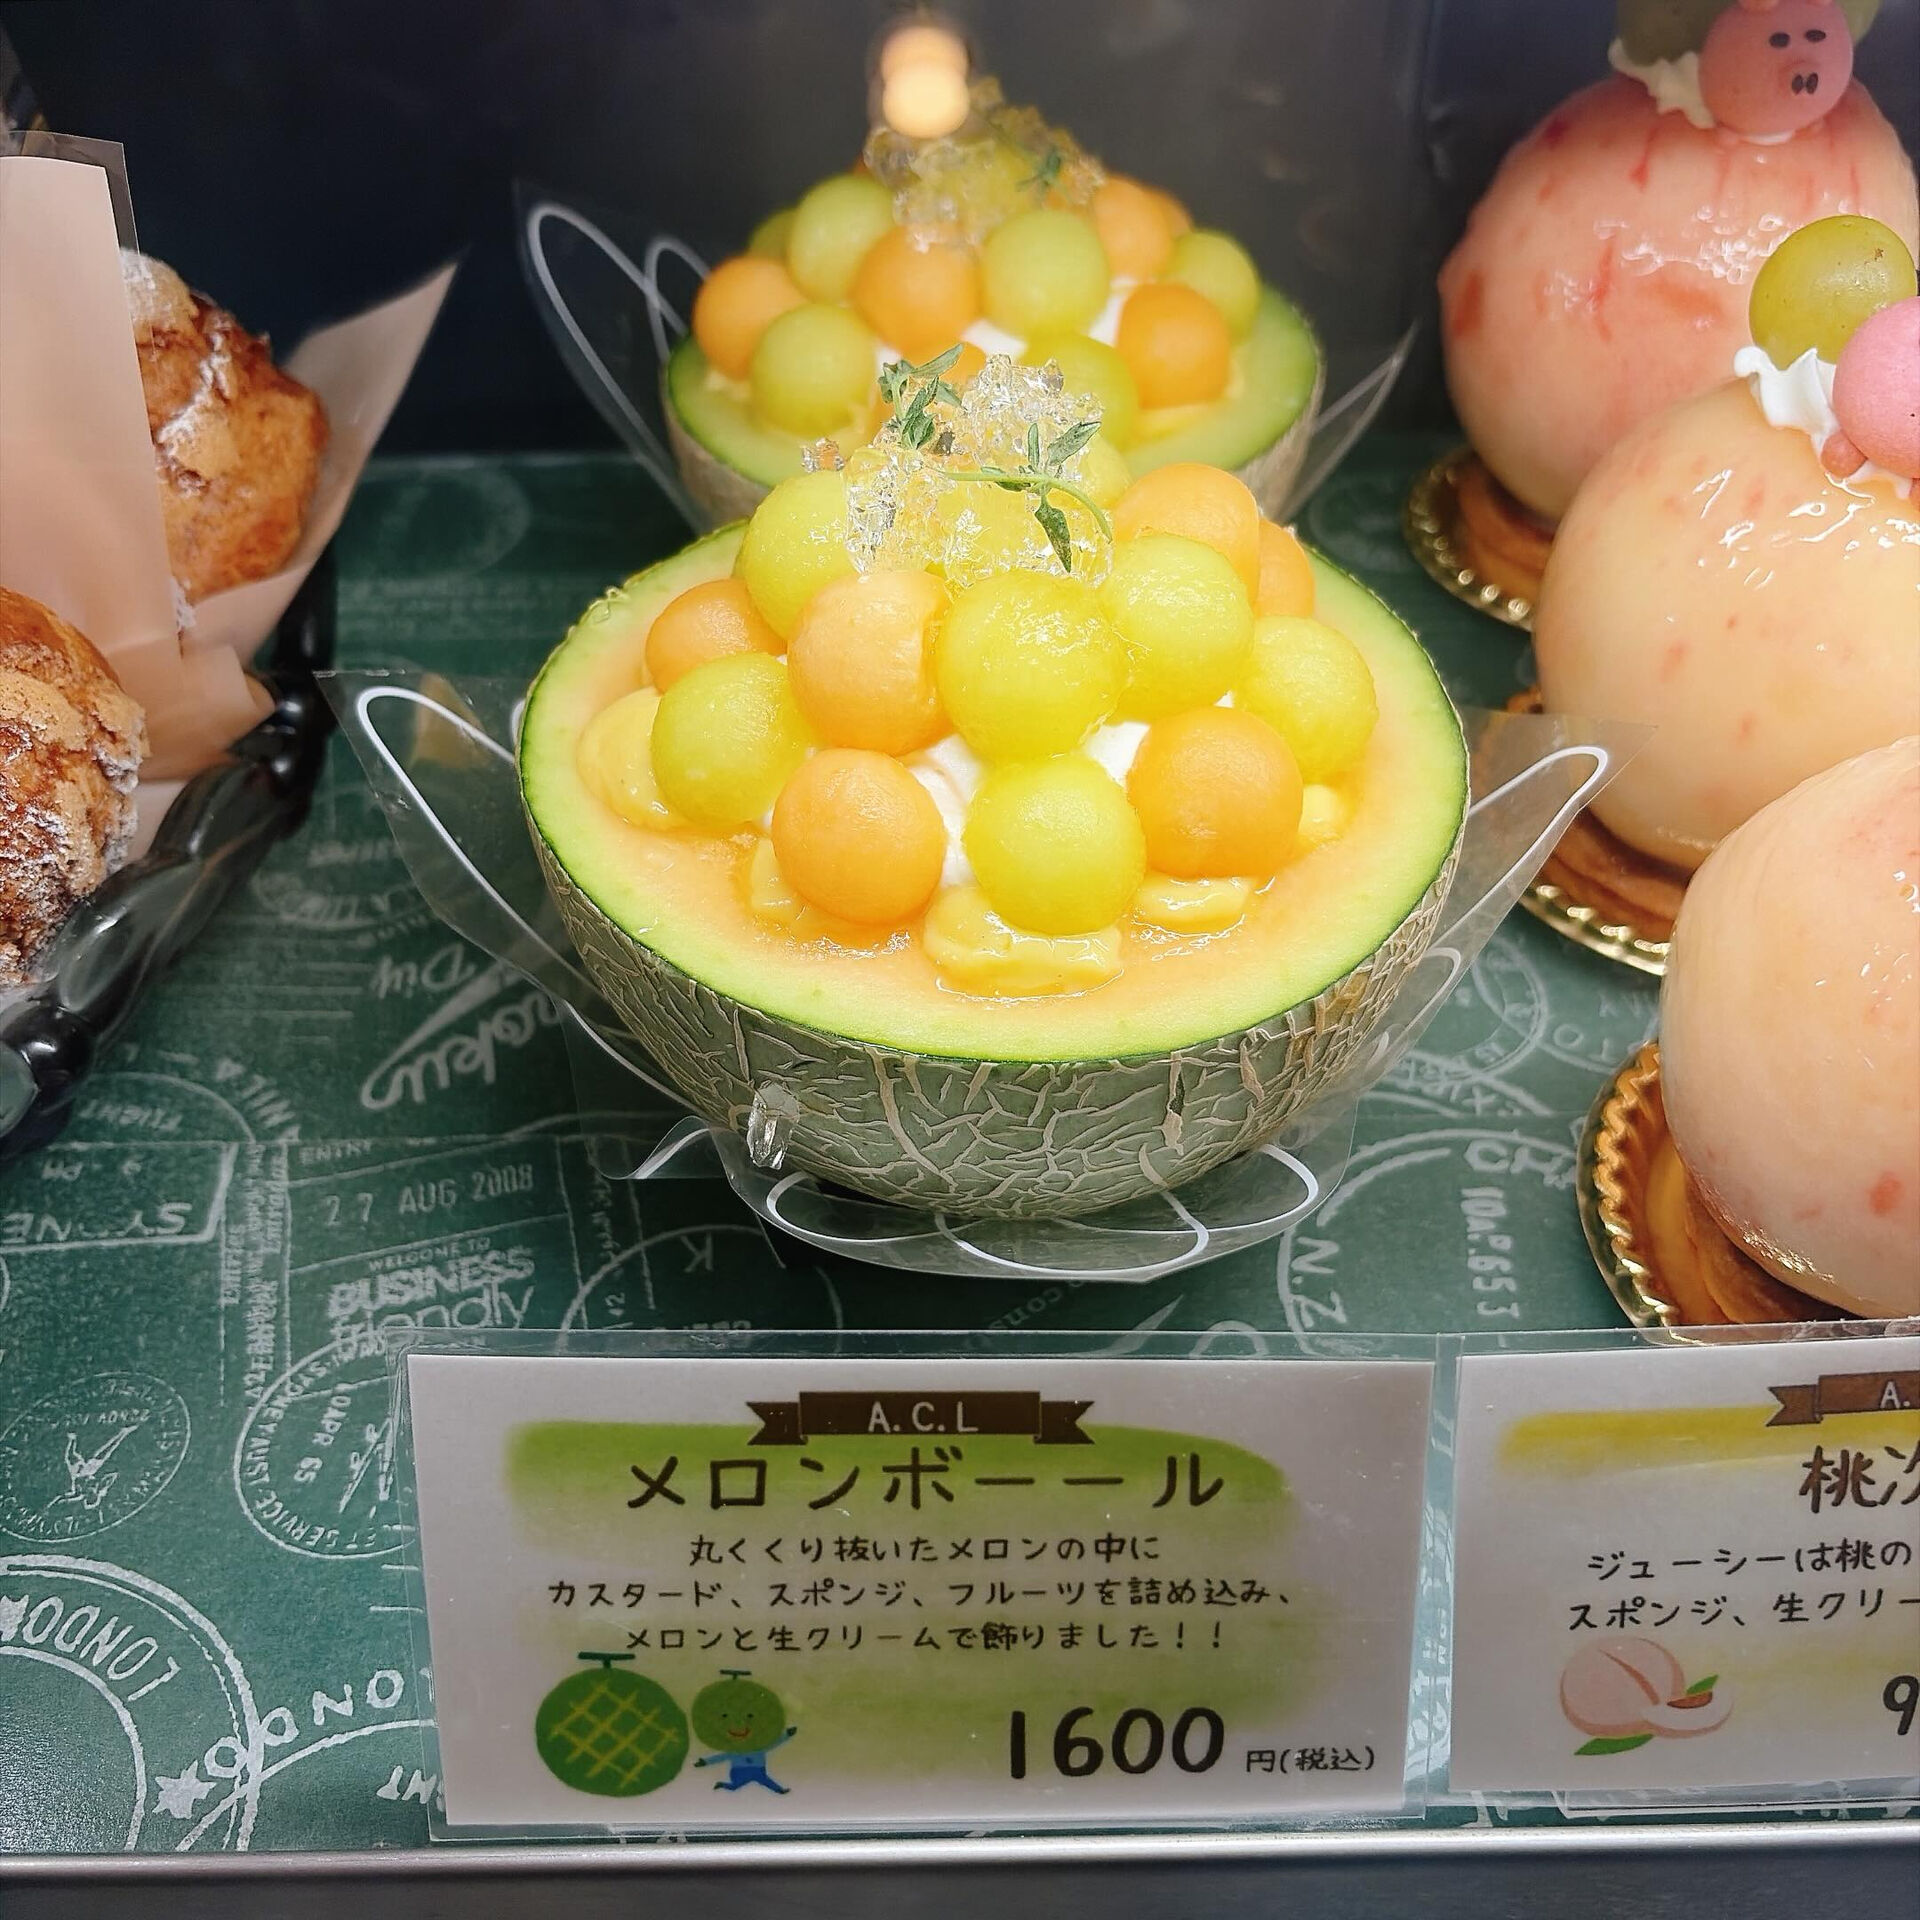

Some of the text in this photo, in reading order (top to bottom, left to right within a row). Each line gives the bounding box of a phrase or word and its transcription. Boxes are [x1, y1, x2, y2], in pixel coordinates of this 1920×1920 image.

[398, 1178, 460, 1216] AUG
[471, 1163, 535, 1202] 2008
[867, 1400, 980, 1435] A.C.L
[625, 1445, 1226, 1512] メロンボーール
[689, 1532, 1161, 1567] 丸くくり抜いたメロンの中に
[548, 1576, 1290, 1609] カスタード、スポンジ、フルーツを詰め込み、
[1009, 1705, 1375, 1780] 1600 円(税込)
